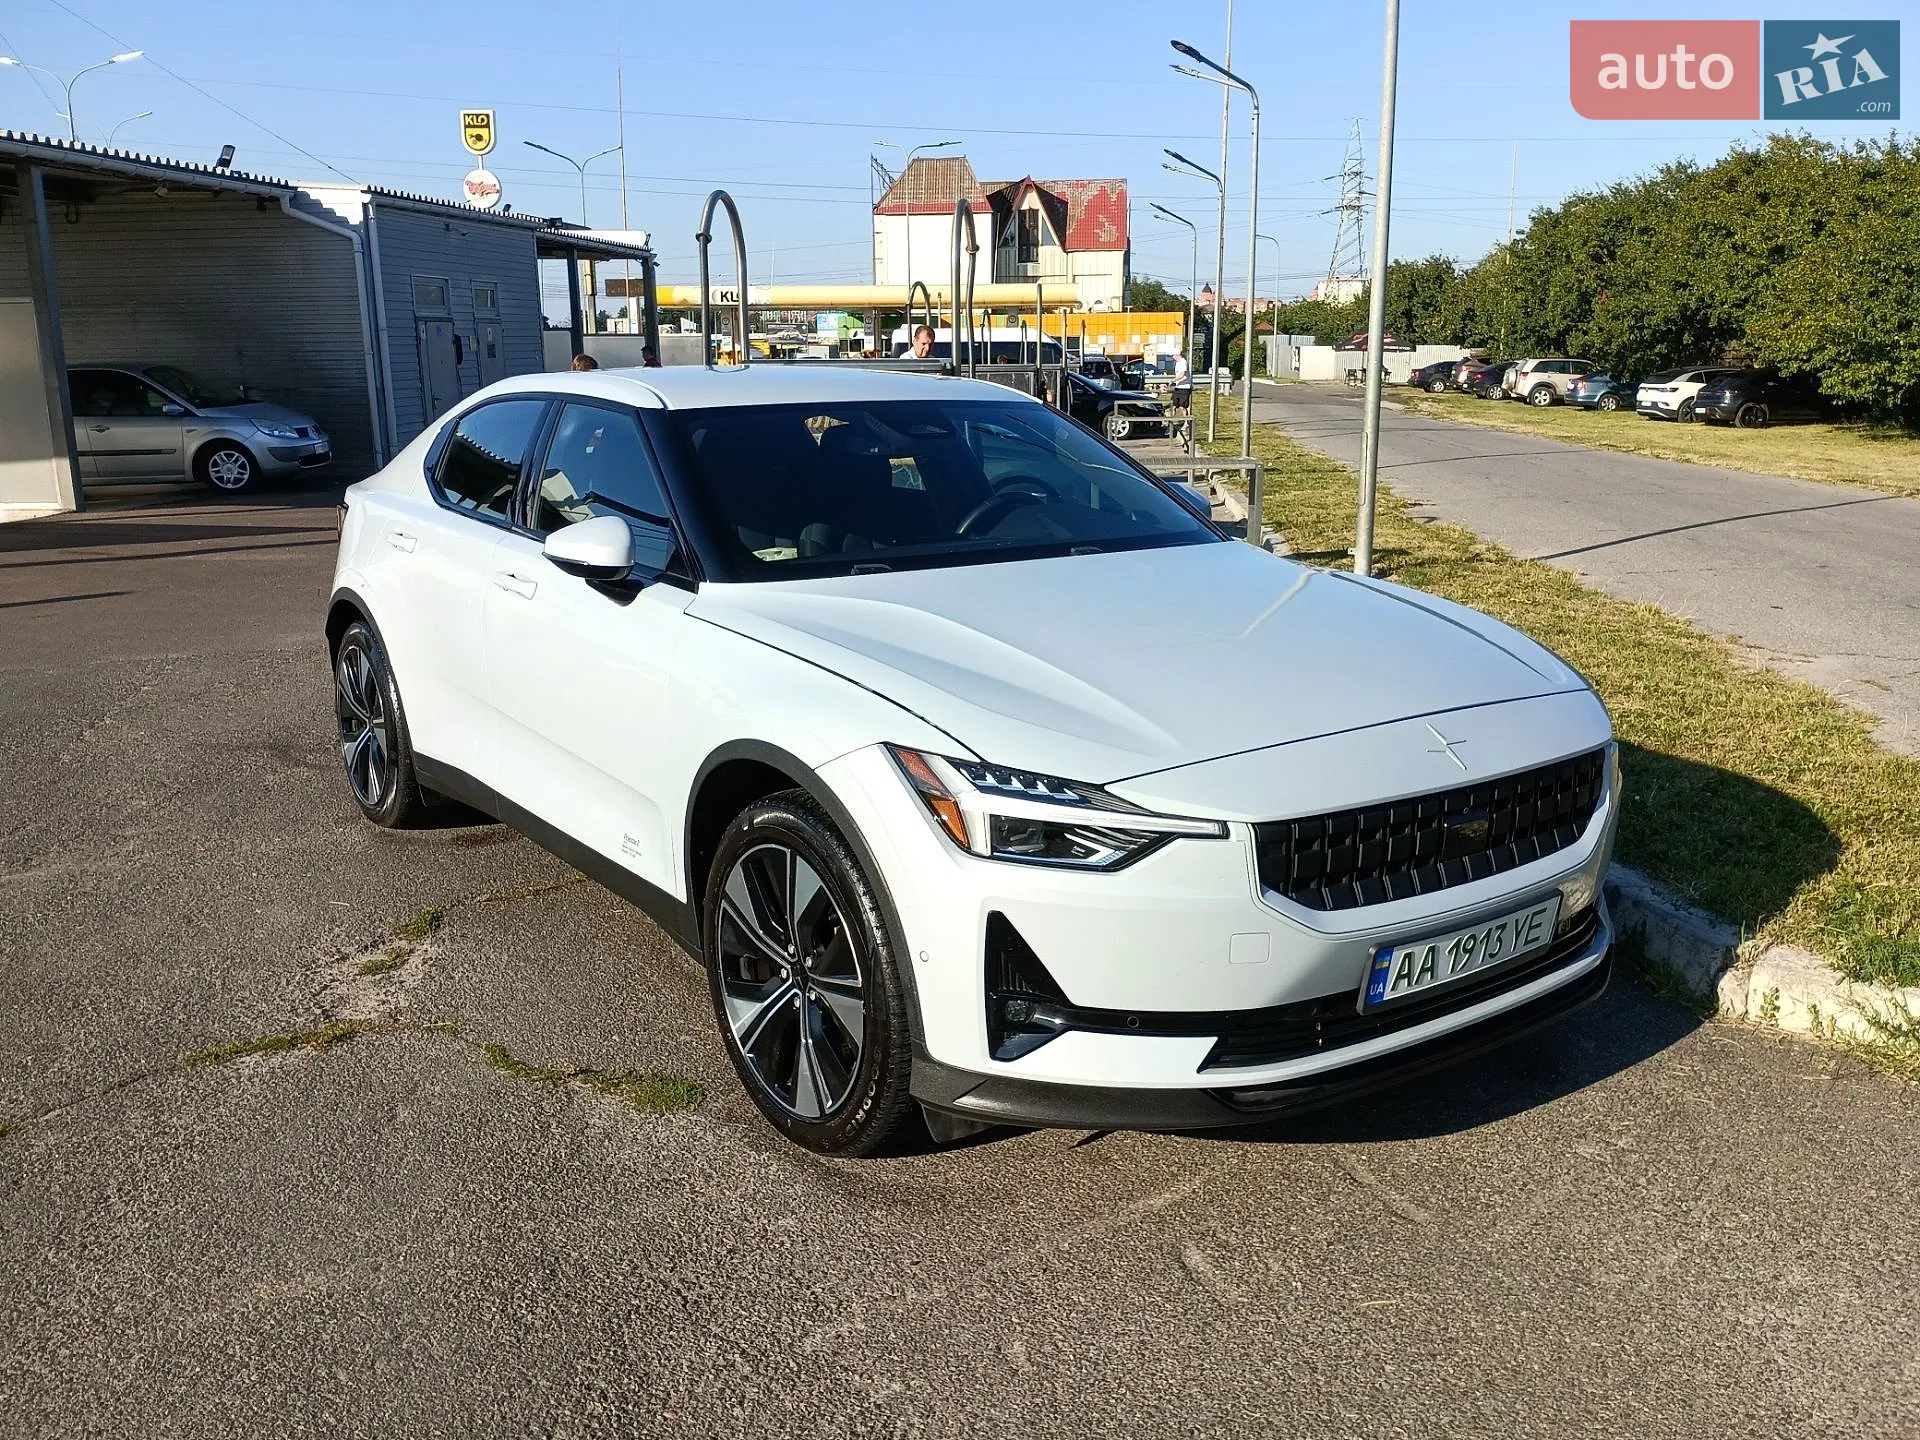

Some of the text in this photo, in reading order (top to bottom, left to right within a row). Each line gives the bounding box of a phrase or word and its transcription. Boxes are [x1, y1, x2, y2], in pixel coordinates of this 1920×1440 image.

[464, 114, 488, 126] KLO
[720, 290, 740, 303] KL
[1389, 908, 1547, 992] AA 1913 YE
[1369, 983, 1385, 996] UA
